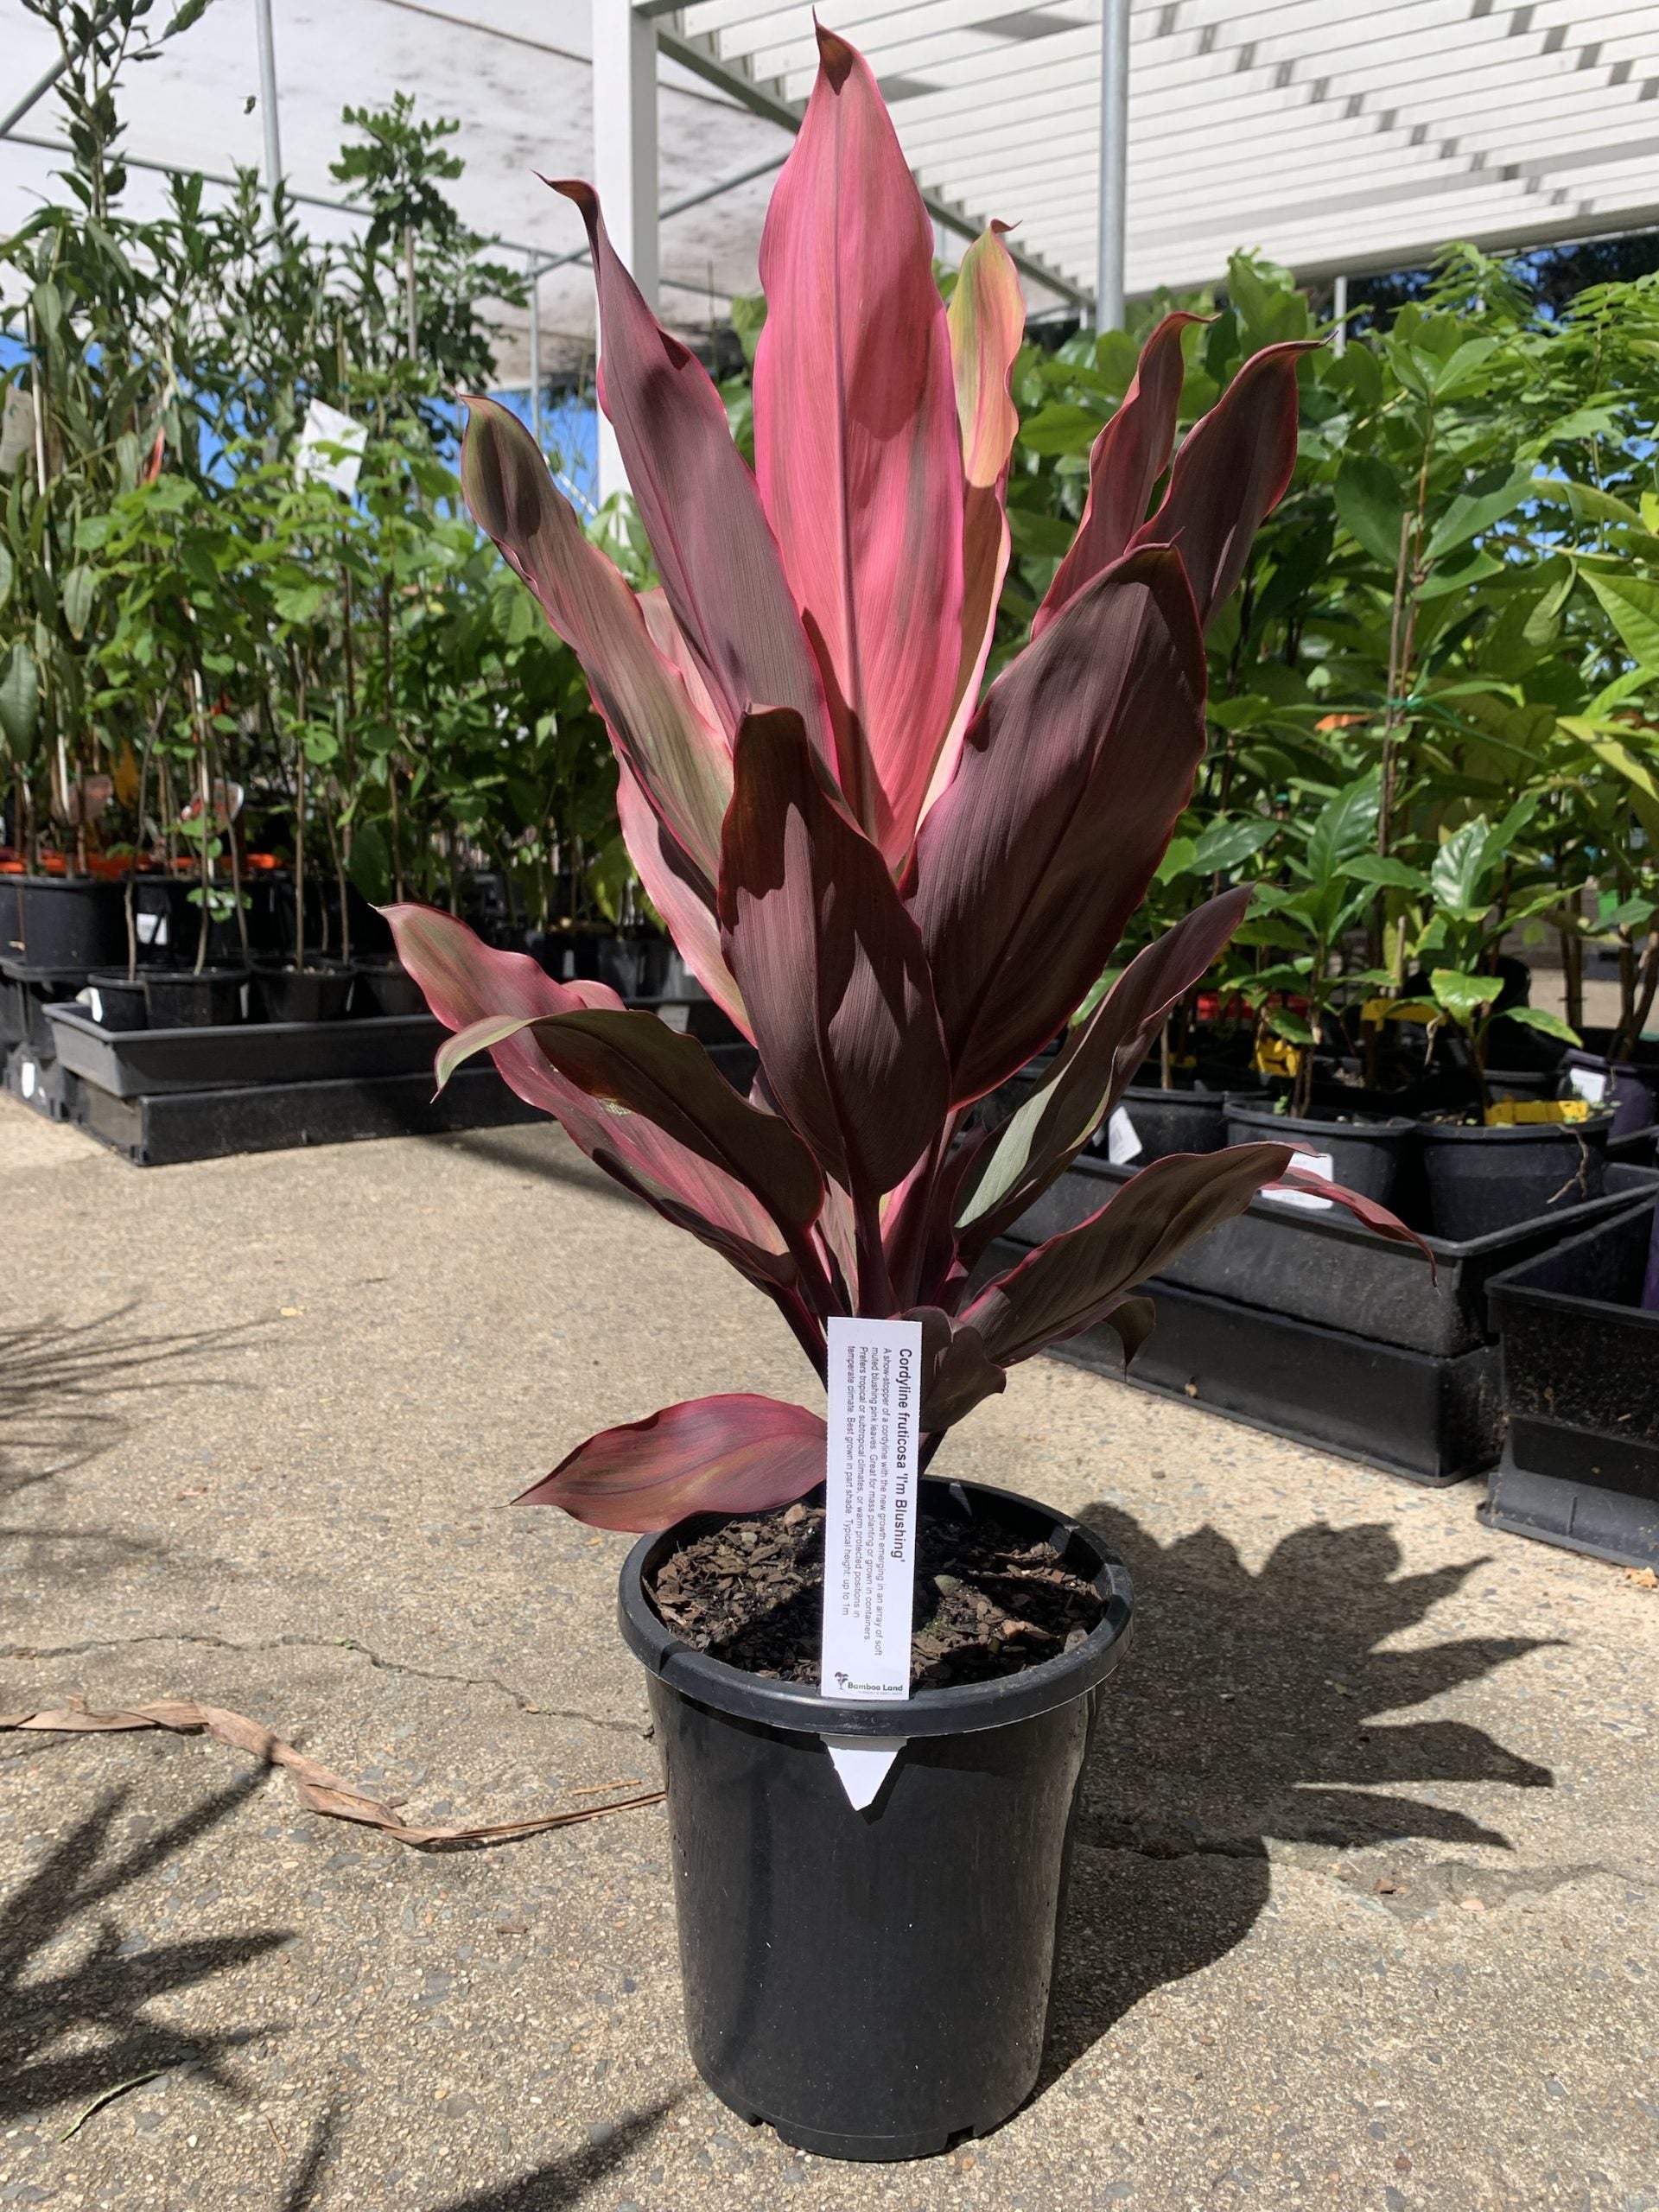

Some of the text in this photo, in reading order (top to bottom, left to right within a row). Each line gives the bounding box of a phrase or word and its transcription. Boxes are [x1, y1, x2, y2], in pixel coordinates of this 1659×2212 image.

[858, 1346, 869, 1375] Prefers
[870, 1346, 880, 1371] muted
[883, 1346, 893, 1356] A
[845, 1345, 856, 1384] temperate
[880, 1355, 893, 1407] show-stopper
[895, 1348, 912, 1409] Cordyline
[856, 1375, 868, 1404] tropical
[868, 1372, 880, 1405] blushing
[858, 1403, 866, 1414] or
[868, 1406, 880, 1422] pink
[881, 1407, 892, 1418] of
[846, 1416, 856, 1435] Best
[855, 1414, 868, 1458] subtropical
[879, 1424, 891, 1460] cordyline
[896, 1411, 910, 1469] fruticosa
[843, 1436, 854, 1461] grown
[846, 1461, 855, 1471] in
[868, 1453, 879, 1477] Great
[880, 1461, 889, 1478] with
[843, 1471, 854, 1488] part
[868, 1478, 878, 1490] for
[880, 1479, 889, 1493] the
[856, 1495, 864, 1506] or
[855, 1506, 864, 1529] warm
[876, 1512, 887, 1541] growth
[842, 1518, 854, 1548] Typical
[865, 1514, 876, 1548] planting
[854, 1530, 864, 1570] protected
[866, 1547, 874, 1559] or
[874, 1541, 886, 1581] emerging
[863, 1559, 874, 1585] grown
[842, 1578, 850, 1591] up
[852, 1571, 862, 1609] positions
[866, 1586, 874, 1596] in
[877, 1582, 886, 1592] in
[842, 1591, 850, 1601] to
[876, 1592, 884, 1605] an
[842, 1602, 851, 1617] 1m
[853, 1609, 862, 1619] in
[874, 1605, 883, 1628] array
[874, 1628, 884, 1639] of
[874, 1639, 883, 1656] soft
[848, 1681, 880, 1691] Bamboo
